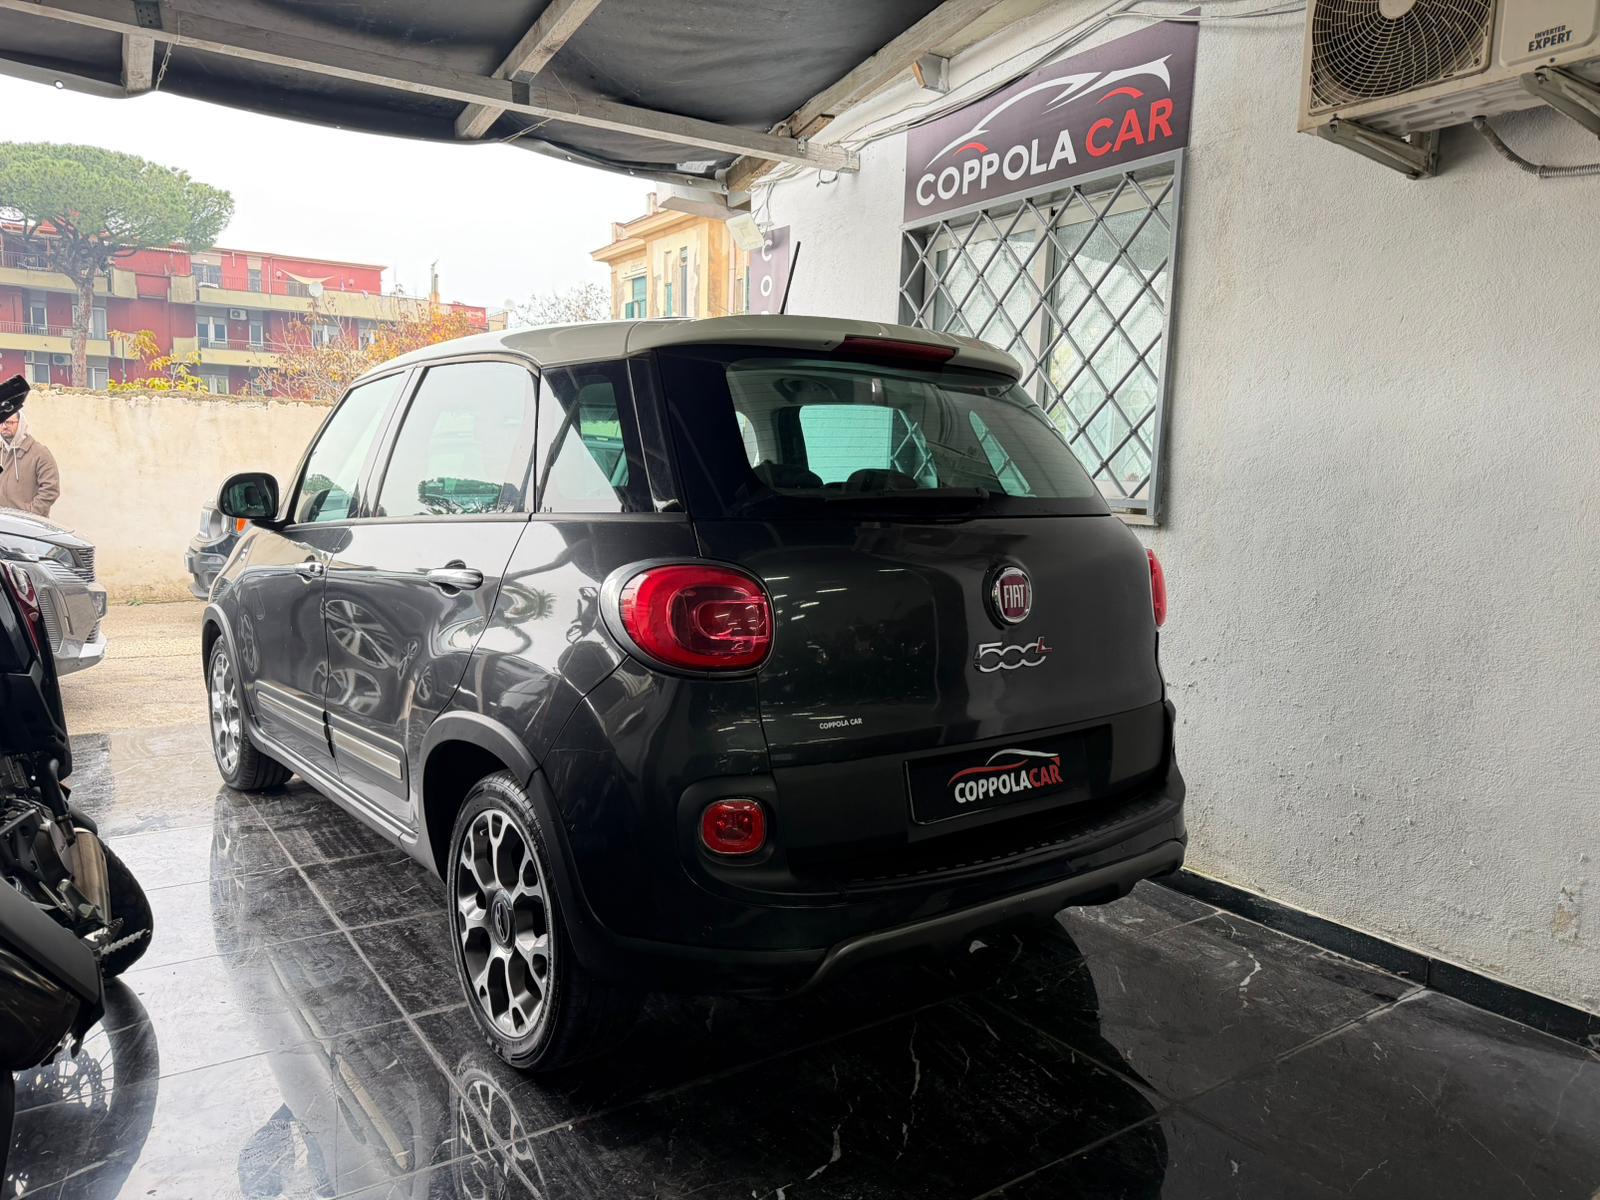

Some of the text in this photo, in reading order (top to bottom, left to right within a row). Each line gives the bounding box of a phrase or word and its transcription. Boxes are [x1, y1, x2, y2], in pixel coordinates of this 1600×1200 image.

[1528, 30, 1573, 52] EXPERT
[1534, 25, 1566, 39] INVERTER
[916, 98, 1174, 206] COPPOLA CAR
[760, 239, 773, 314] CO
[1003, 584, 1025, 609] FIAT
[819, 717, 863, 730] COPPOLA CAR
